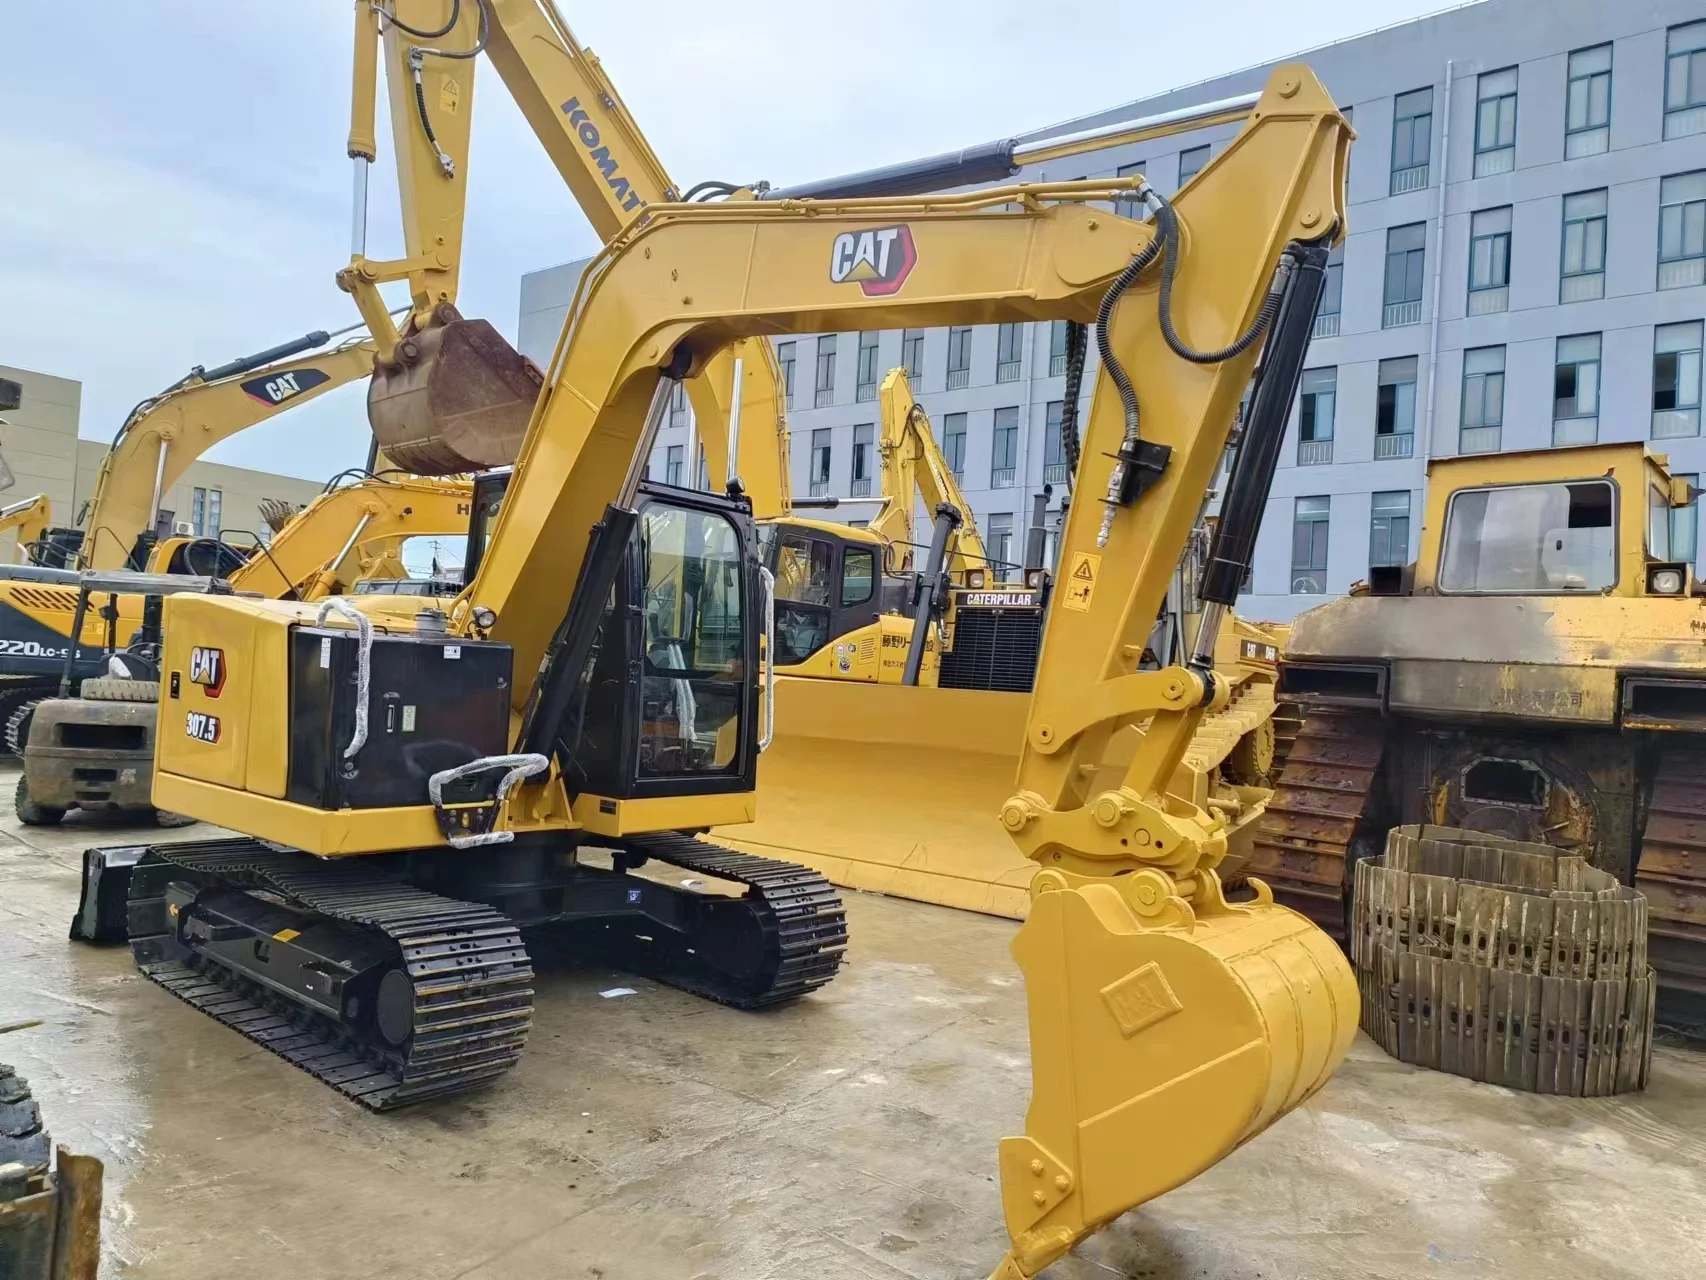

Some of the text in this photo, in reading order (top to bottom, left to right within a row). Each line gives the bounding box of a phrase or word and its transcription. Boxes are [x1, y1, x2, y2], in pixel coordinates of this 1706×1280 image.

[831, 229, 898, 282] CAT
[265, 372, 301, 401] CAT
[967, 593, 1032, 605] CATERPILLAR
[190, 646, 220, 685] CAT
[186, 712, 216, 741] 307.5
